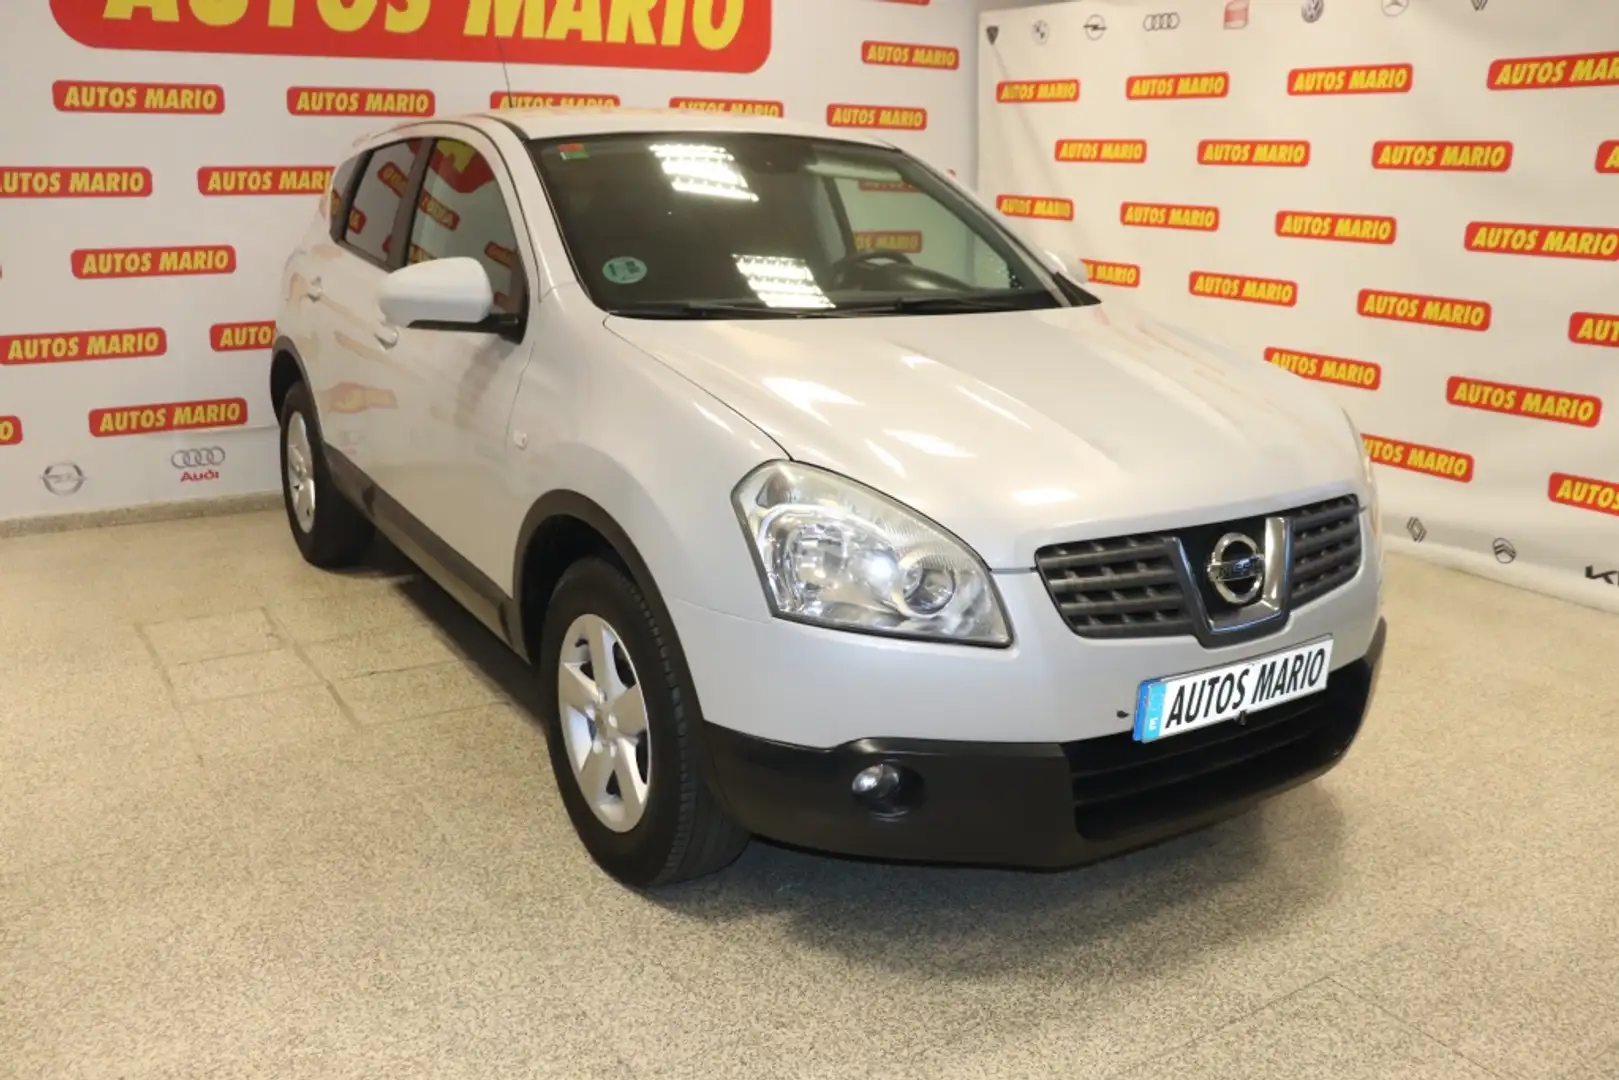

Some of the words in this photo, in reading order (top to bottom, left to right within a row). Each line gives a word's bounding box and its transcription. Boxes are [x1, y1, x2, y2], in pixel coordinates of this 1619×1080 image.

[867, 45, 909, 63] AUTOS
[912, 48, 956, 67] MARIO
[1294, 71, 1346, 91] AUTOS
[1349, 69, 1408, 89] MARIO
[1495, 62, 1567, 84] AUTOS
[1000, 84, 1035, 100] AUTOS
[1037, 83, 1077, 99] MARIO
[1131, 79, 1173, 96] AUTOS
[1177, 76, 1224, 94] MARIO
[65, 87, 136, 108] AUTOS
[144, 88, 216, 110] MARIO
[296, 91, 359, 111] AUTOS
[365, 93, 428, 112] MARIO
[832, 108, 876, 124] AUTOS
[879, 110, 923, 127] MARIO
[1060, 142, 1098, 159] AUTOS
[1101, 143, 1143, 160] MARIO
[1204, 144, 1250, 161] AUTOS
[1253, 144, 1305, 163] MARIO
[1379, 145, 1437, 165] AUTOS
[1441, 146, 1506, 167] MARIO
[0, 172, 61, 193] UTOS
[69, 172, 144, 192] MARIO
[208, 171, 272, 191] AUTOS
[1000, 197, 1031, 214] AUTOS
[1033, 199, 1071, 217] MARIO
[1125, 206, 1167, 223] AUTOS
[1168, 208, 1215, 227] MARIO
[1281, 215, 1331, 235] AUTOS
[1335, 219, 1391, 240] MARIO
[1472, 227, 1538, 250] AUTOS
[1542, 231, 1619, 255] MARIO
[83, 253, 152, 274] AUTOS
[159, 250, 228, 271] MARIO
[1194, 276, 1239, 295] AUTOS
[1243, 281, 1293, 301] MARIO
[1364, 295, 1419, 317] AUTOS
[1423, 302, 1484, 325] MARIO
[8, 337, 79, 360] AUTOS
[87, 332, 158, 355] MARIO
[1321, 361, 1375, 385] MARIO
[1455, 383, 1516, 408] AUTOS
[1522, 393, 1594, 421] MARIO
[100, 408, 166, 432] AUTOS
[173, 404, 240, 425] MARIO
[1407, 447, 1467, 477] MARIO
[180, 470, 219, 482] Audi
[1165, 668, 1250, 729] AUTOS
[1251, 647, 1326, 705] MARIO
